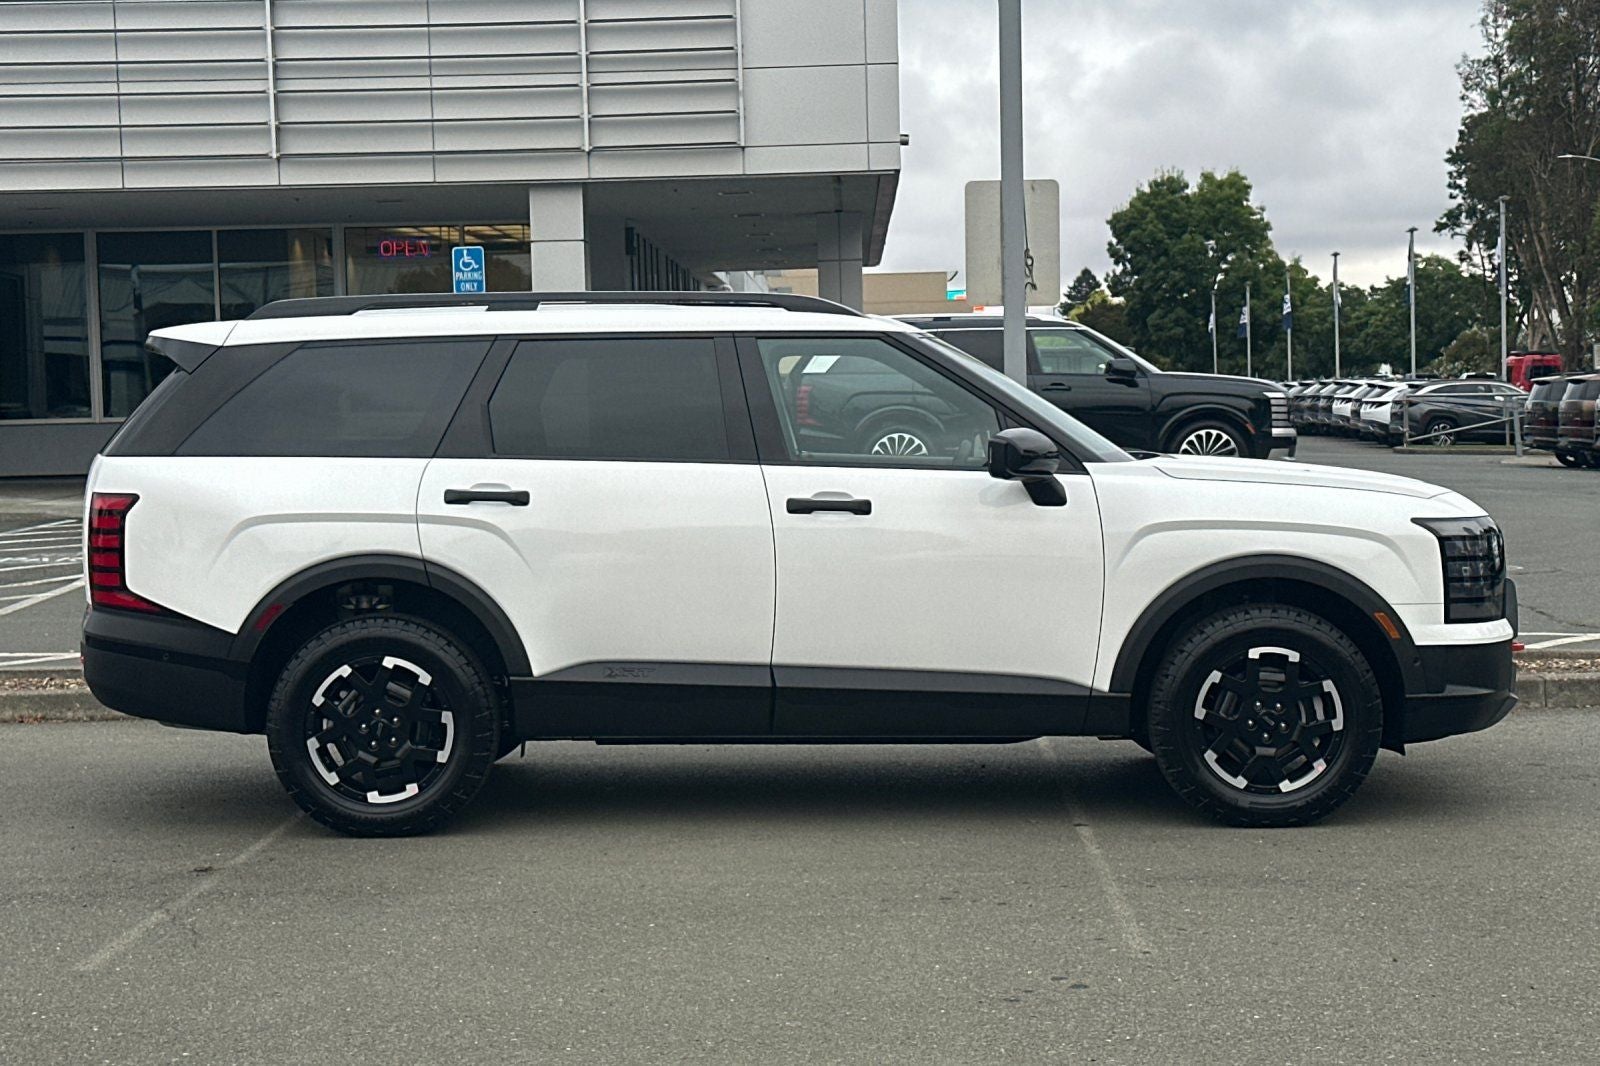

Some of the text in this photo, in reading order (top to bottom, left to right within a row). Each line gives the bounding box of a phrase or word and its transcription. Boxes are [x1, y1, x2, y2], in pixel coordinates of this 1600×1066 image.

[380, 240, 429, 257] OPEN
[455, 271, 483, 281] PARKING
[460, 281, 478, 291] ONLY
